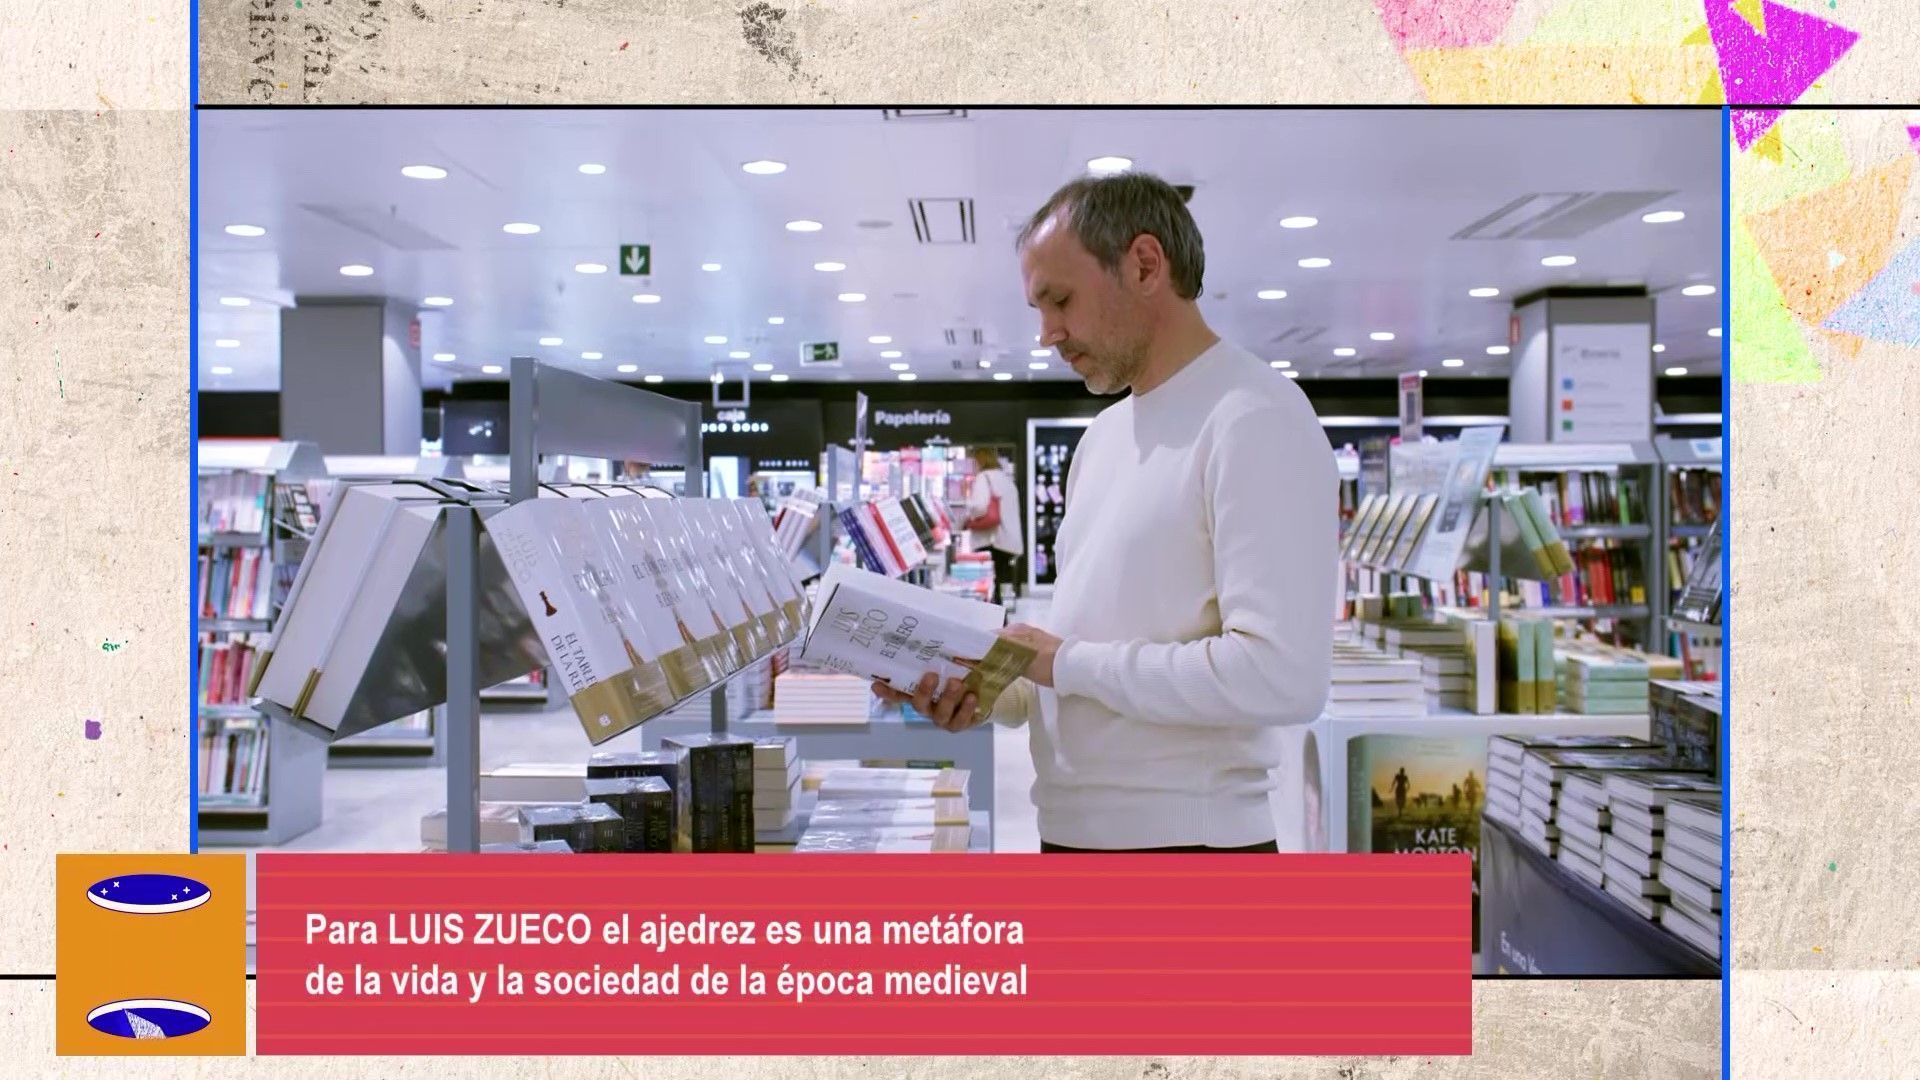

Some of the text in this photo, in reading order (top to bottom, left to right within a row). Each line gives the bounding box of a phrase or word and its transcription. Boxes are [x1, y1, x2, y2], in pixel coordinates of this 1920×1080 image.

[717, 409, 746, 422] caja
[874, 409, 950, 427] Papelería
[565, 632, 579, 649] EL
[551, 635, 567, 653] DE
[560, 653, 573, 671] LA
[1415, 828, 1456, 844] KATE
